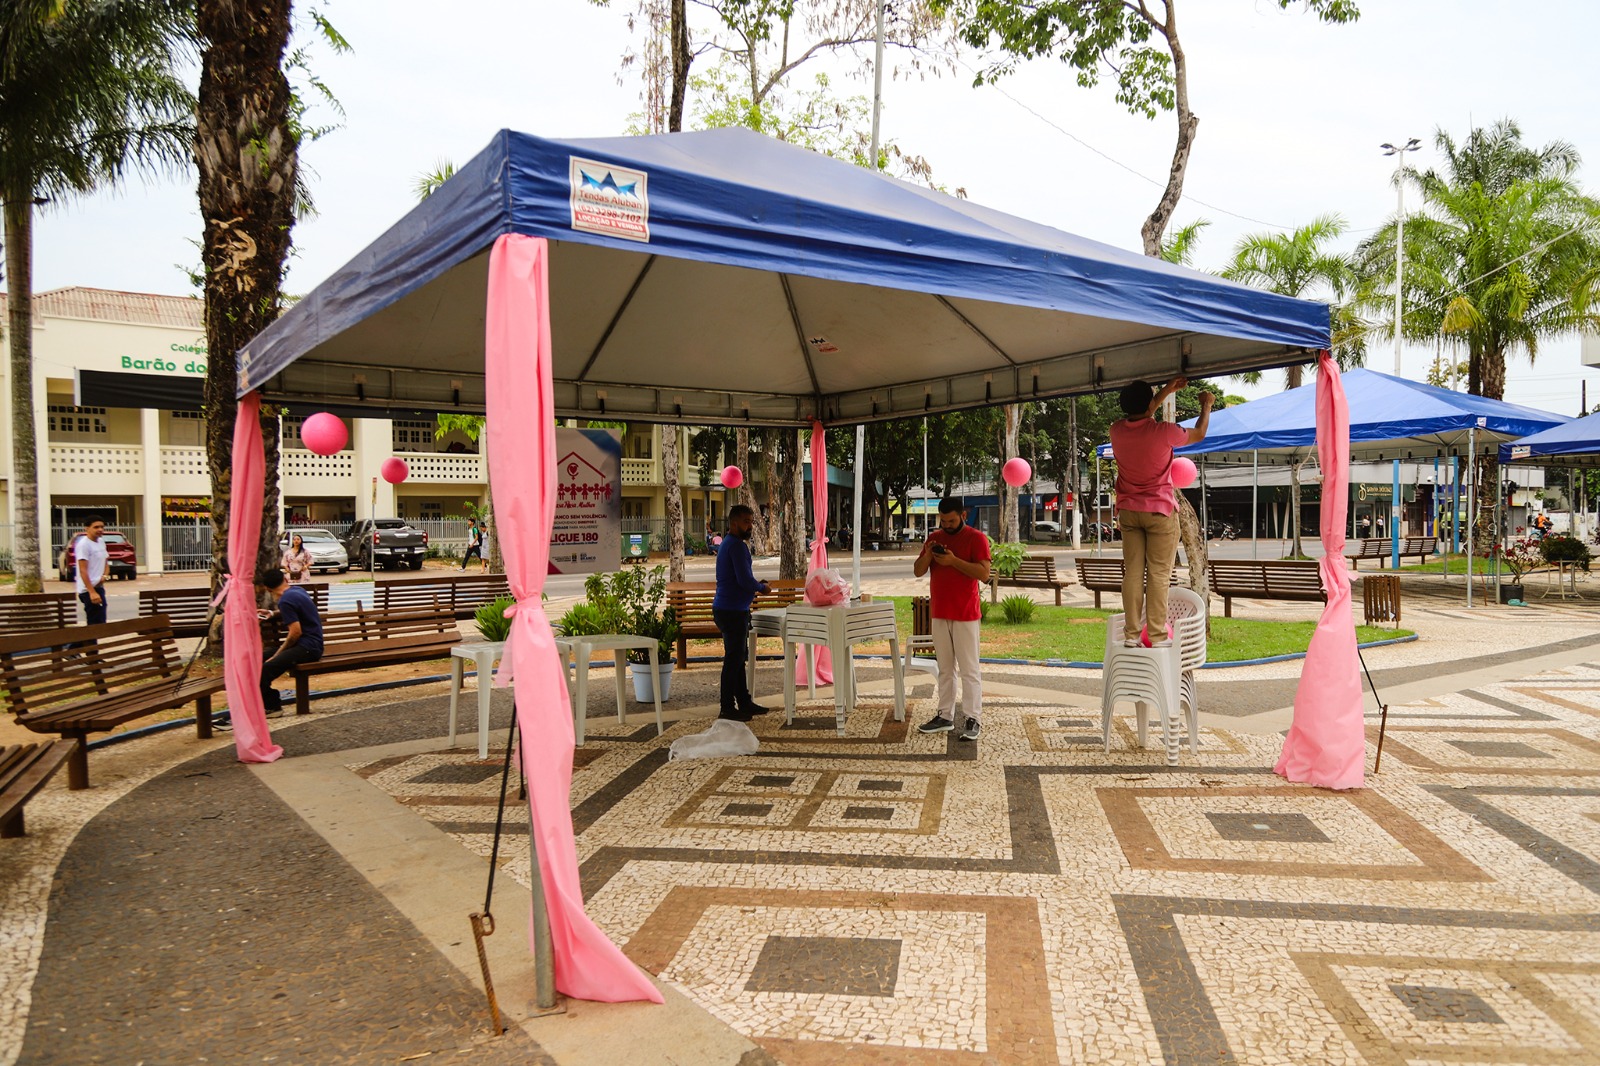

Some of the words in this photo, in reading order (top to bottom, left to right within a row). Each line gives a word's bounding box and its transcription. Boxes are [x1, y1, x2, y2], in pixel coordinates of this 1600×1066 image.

[580, 190, 609, 202] Tendas
[611, 196, 642, 209] Aluban
[578, 204, 594, 213] (62)
[596, 207, 641, 223] 3298-7102
[578, 213, 610, 227] LOCAÇÃO
[617, 221, 643, 231] VENDAS
[170, 343, 208, 355] Colégio
[121, 355, 176, 371] Barão
[184, 361, 207, 373] do
[550, 533, 580, 542] LIGUE
[581, 532, 599, 541] 180
